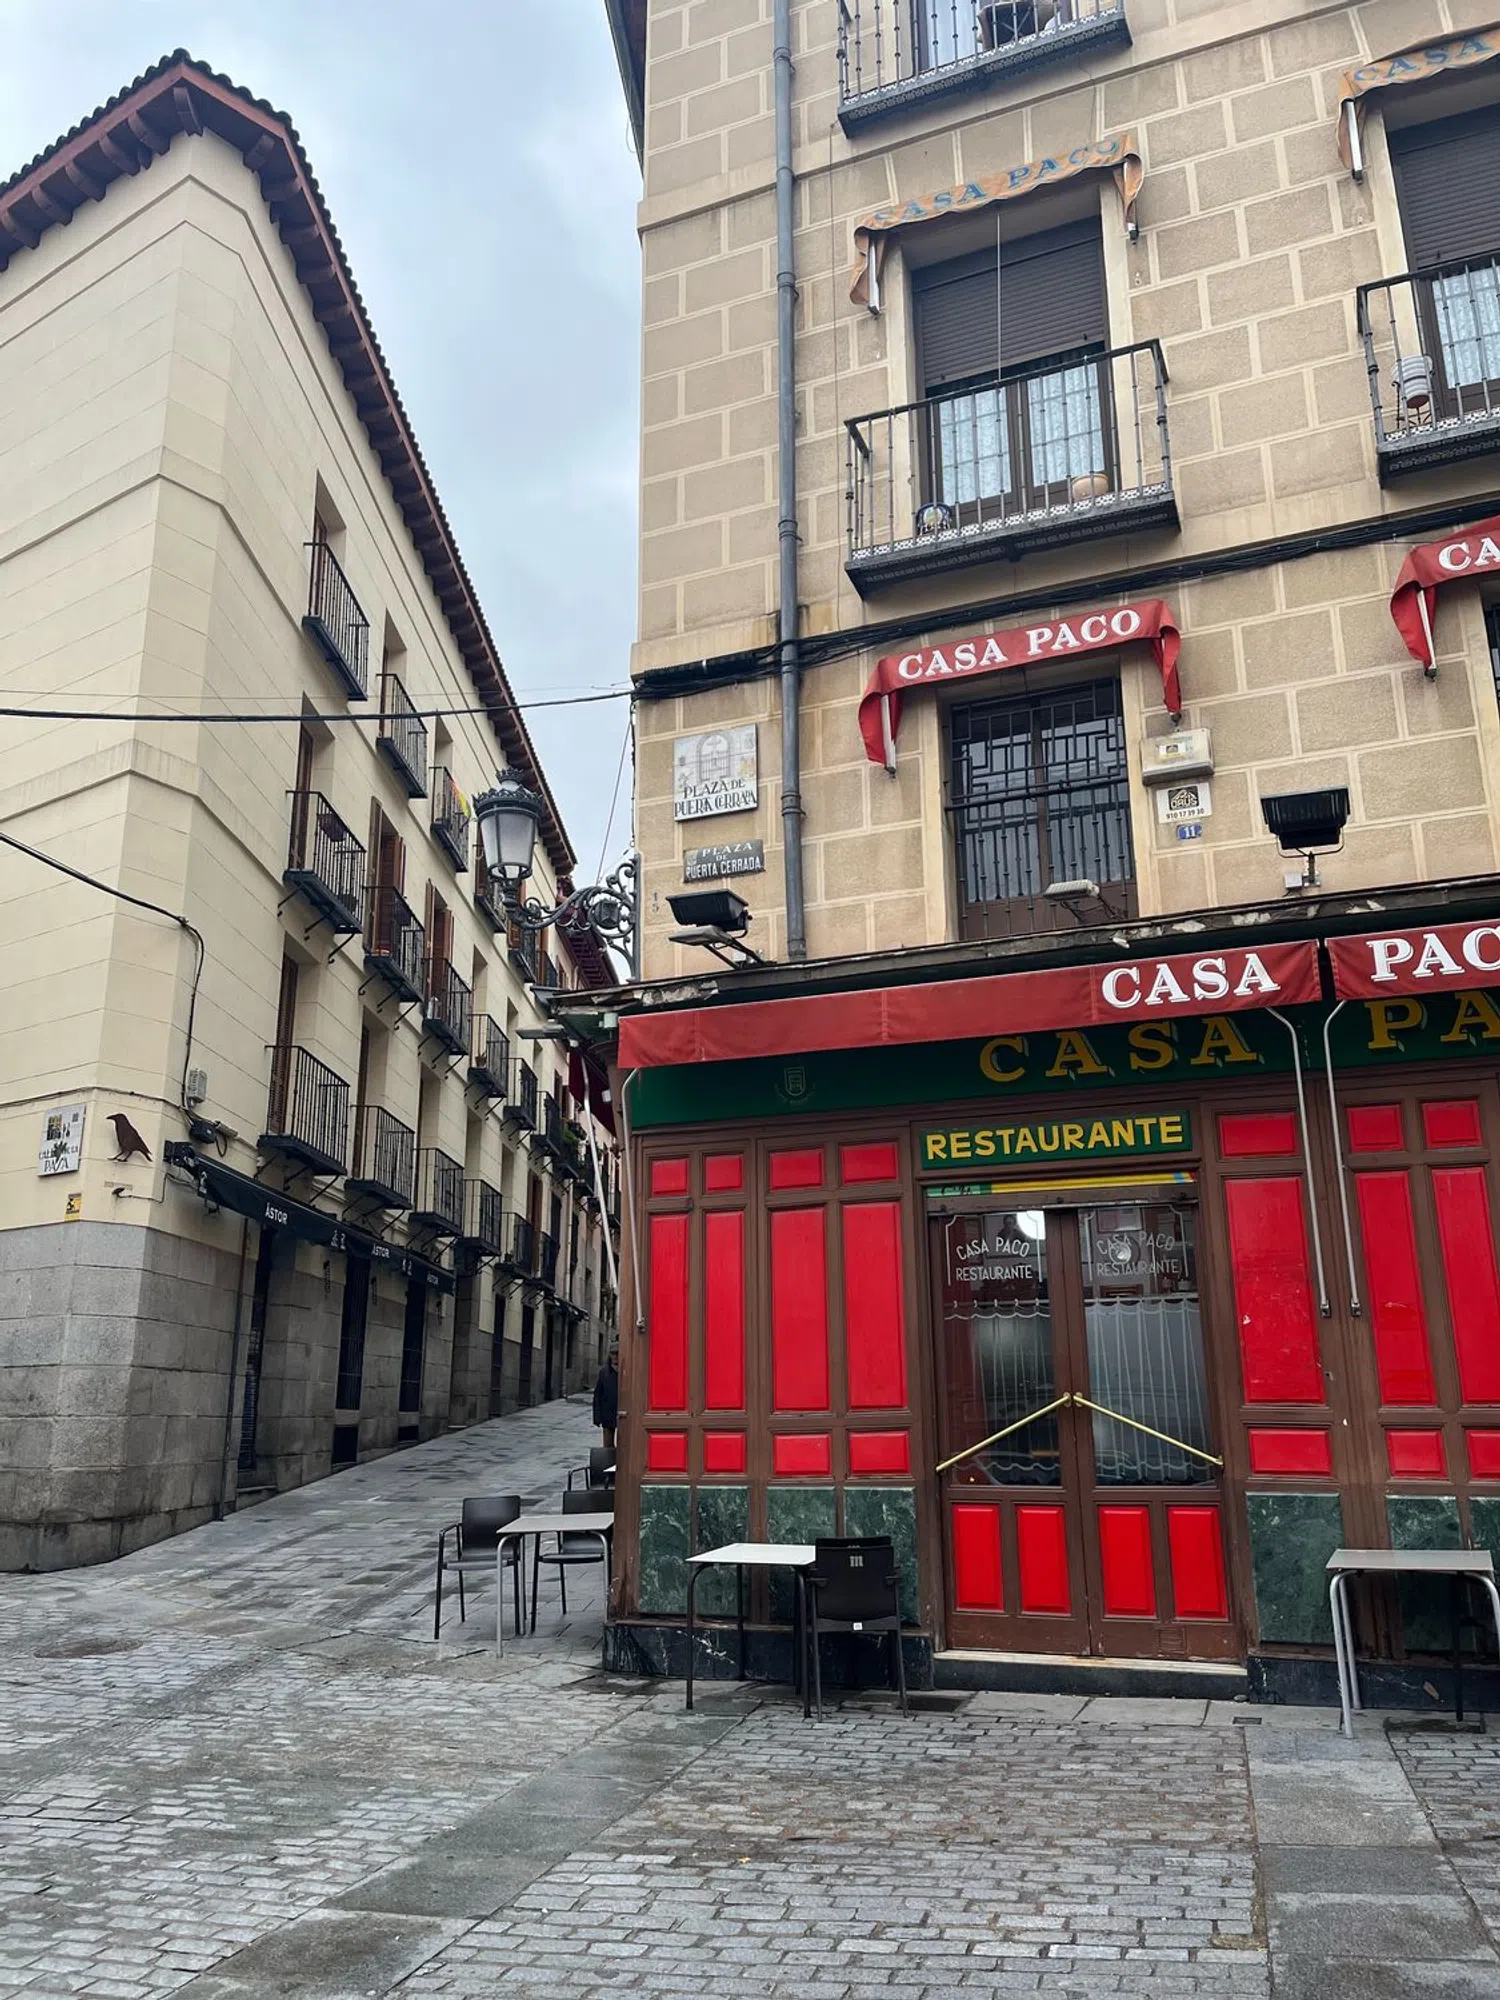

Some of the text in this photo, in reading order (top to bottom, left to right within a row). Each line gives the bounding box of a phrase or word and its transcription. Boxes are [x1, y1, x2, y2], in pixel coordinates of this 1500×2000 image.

[1354, 37, 1493, 81] CASA
[874, 138, 1119, 221] CASA PACO
[899, 609, 1141, 680] CASA PACO
[683, 778, 746, 799] PLAZA DE
[1184, 823, 1196, 838] 11
[702, 842, 753, 857] PLAZA
[685, 856, 761, 879] PUERTA CERRADA
[1101, 927, 1500, 1009] CASA PAC
[979, 992, 1500, 1083] CASA PA
[926, 1115, 1183, 1160] RESTAURANTE
[956, 1237, 1030, 1260] CASA PACO
[1097, 1231, 1175, 1255] CASA PACO
[955, 1265, 1033, 1281] RESTAURANTE
[1097, 1259, 1180, 1277] RESTAURANTE
